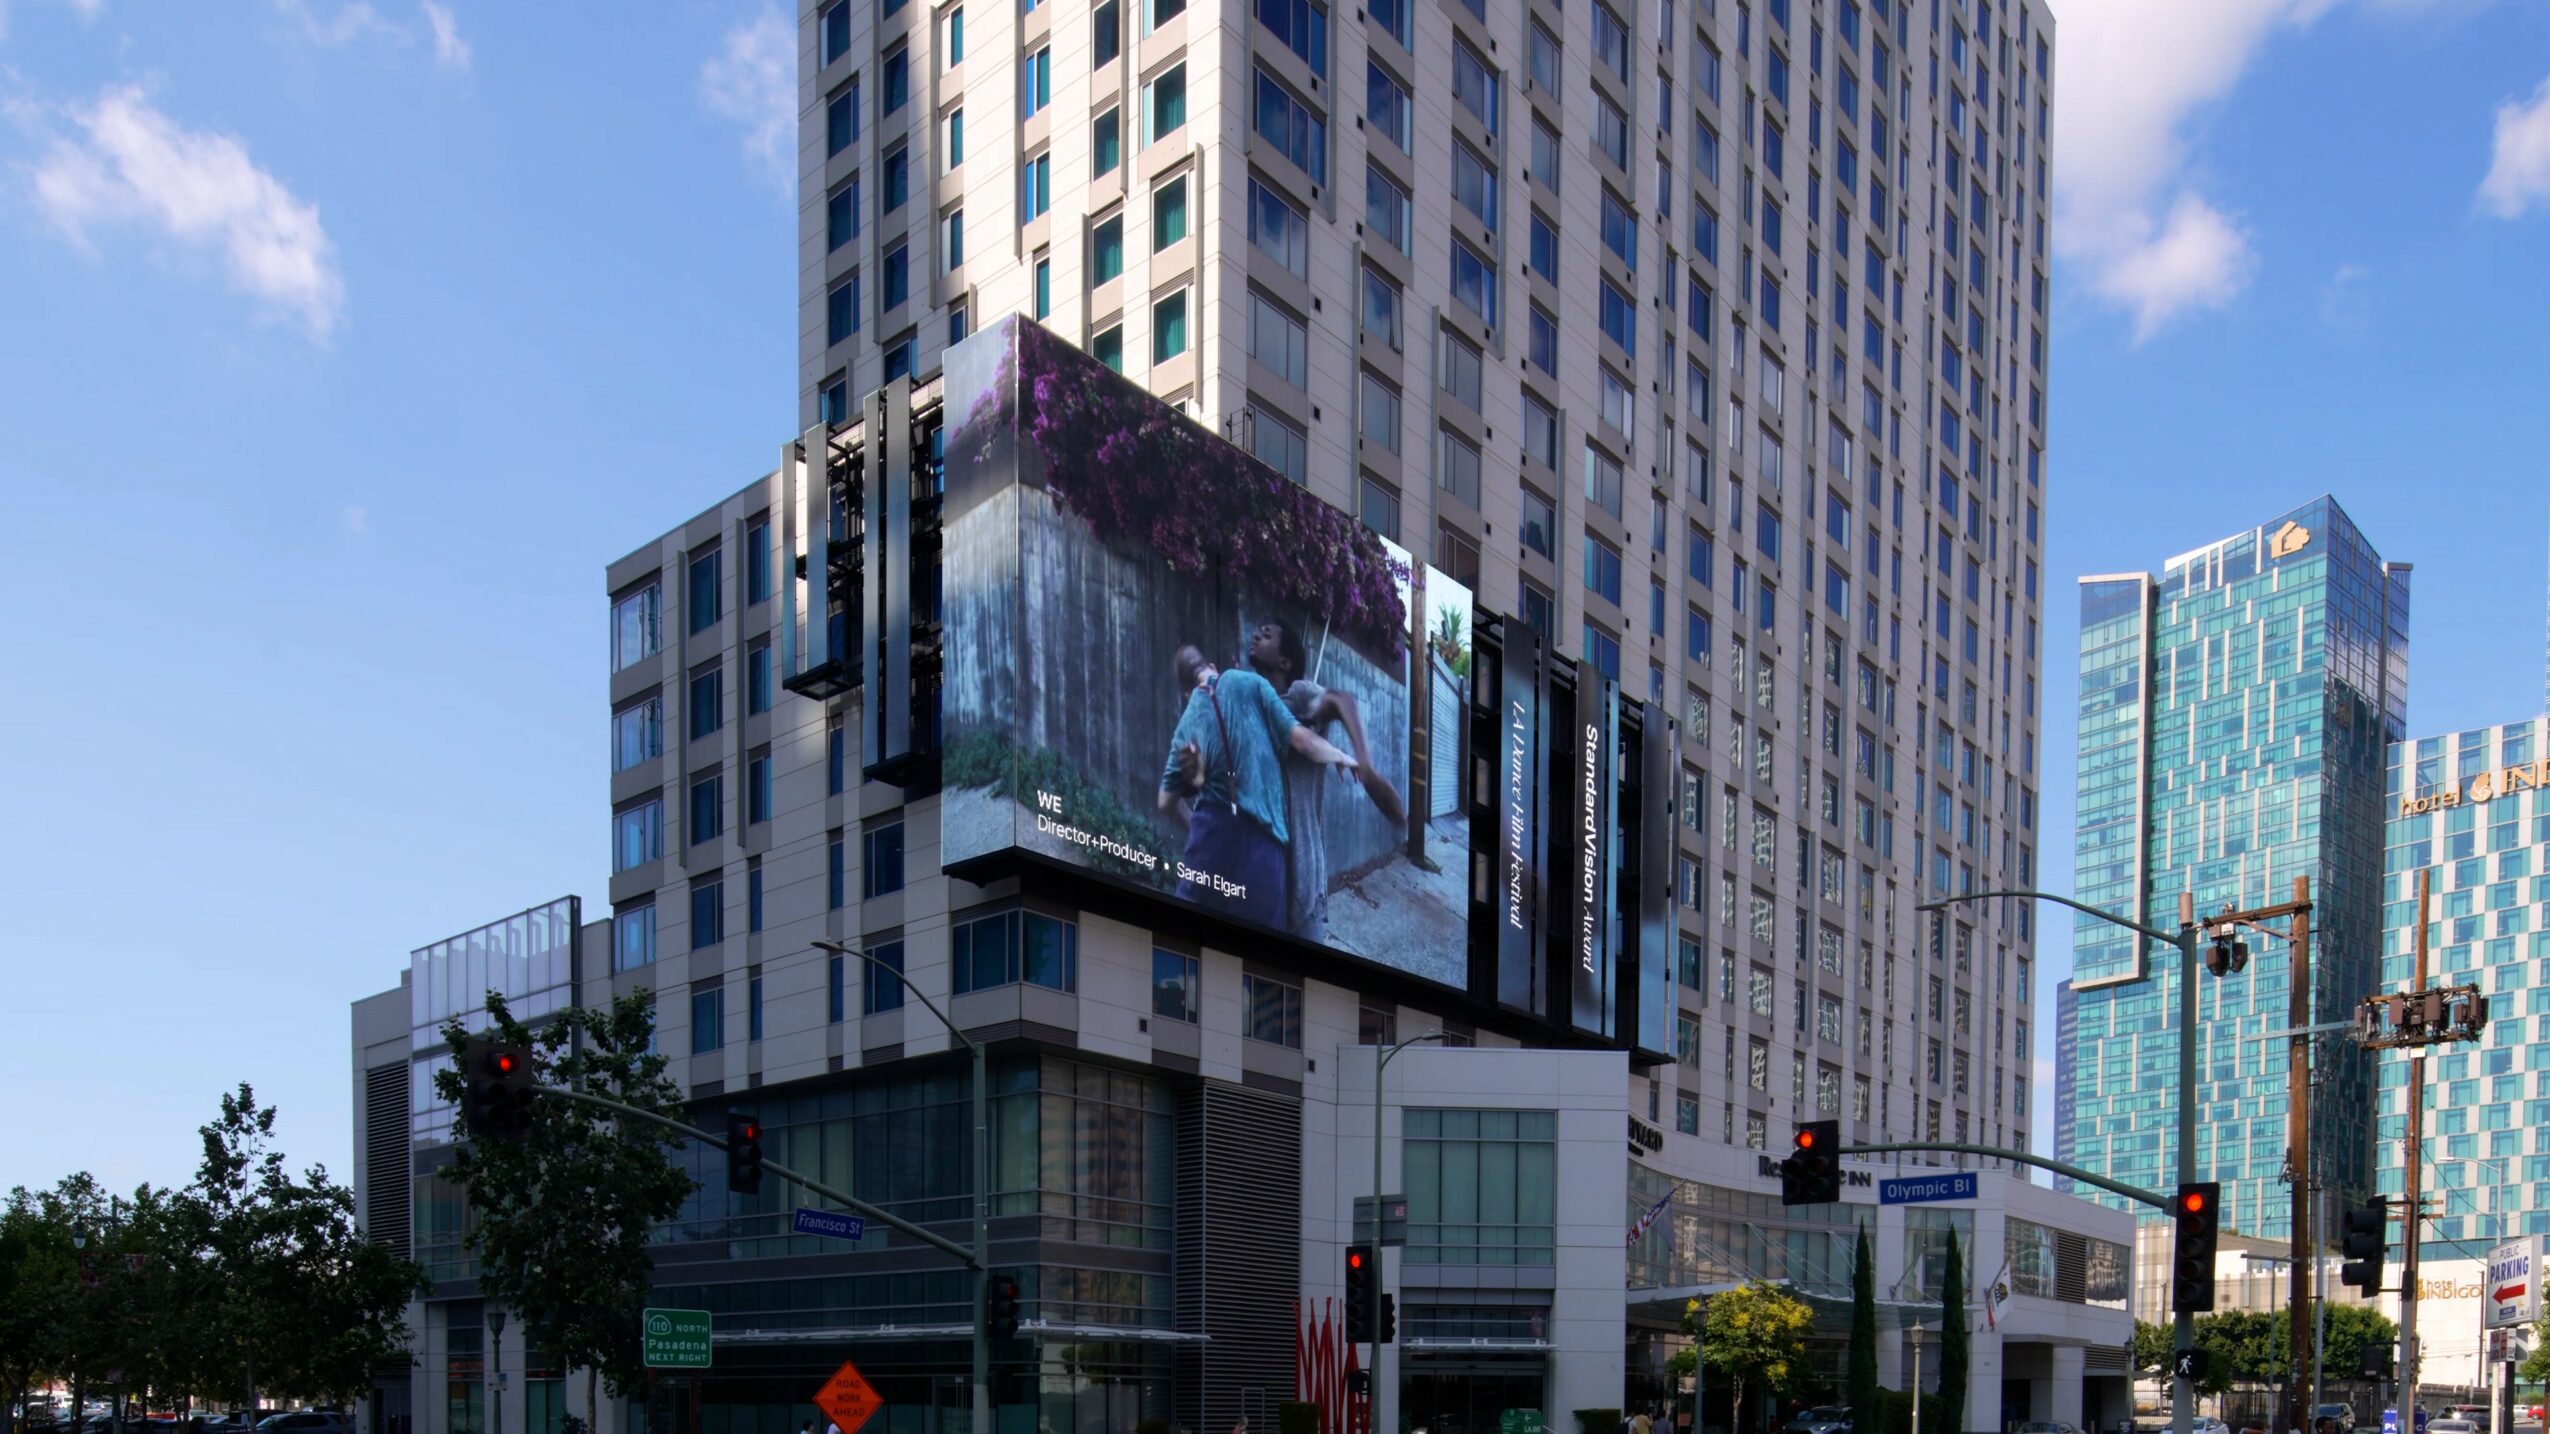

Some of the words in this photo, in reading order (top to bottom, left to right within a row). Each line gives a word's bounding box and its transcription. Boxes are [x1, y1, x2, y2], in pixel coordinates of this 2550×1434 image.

[1511, 737, 1526, 801] Dance
[1036, 789, 1062, 814] WE
[2401, 783, 2462, 817] hotel
[1583, 723, 1599, 903] StandardVision
[1510, 802, 1525, 850] Film
[1037, 813, 1158, 870] Director+Producer
[1176, 861, 1211, 888] Sarah
[1213, 874, 1247, 900] Elgart
[1509, 850, 1524, 930] Festival
[1582, 905, 1597, 974] Award
[1848, 1171, 1871, 1188] INN
[1887, 1180, 1948, 1200] Olympic
[798, 1213, 847, 1233] Francisco
[849, 1221, 861, 1235] St
[2500, 1245, 2520, 1260] PUBLIC
[2489, 1256, 2529, 1285] PARKING
[2426, 1286, 2482, 1299] INDIGO
[2427, 1278, 2457, 1289] hotel
[652, 1321, 668, 1332] 110
[676, 1324, 708, 1333] NORTH
[648, 1339, 707, 1351] Pasadena
[648, 1353, 674, 1361] NEXT
[678, 1353, 707, 1362] RIGHT
[836, 1379, 861, 1389] ROAD
[833, 1407, 865, 1417] AHEAD
